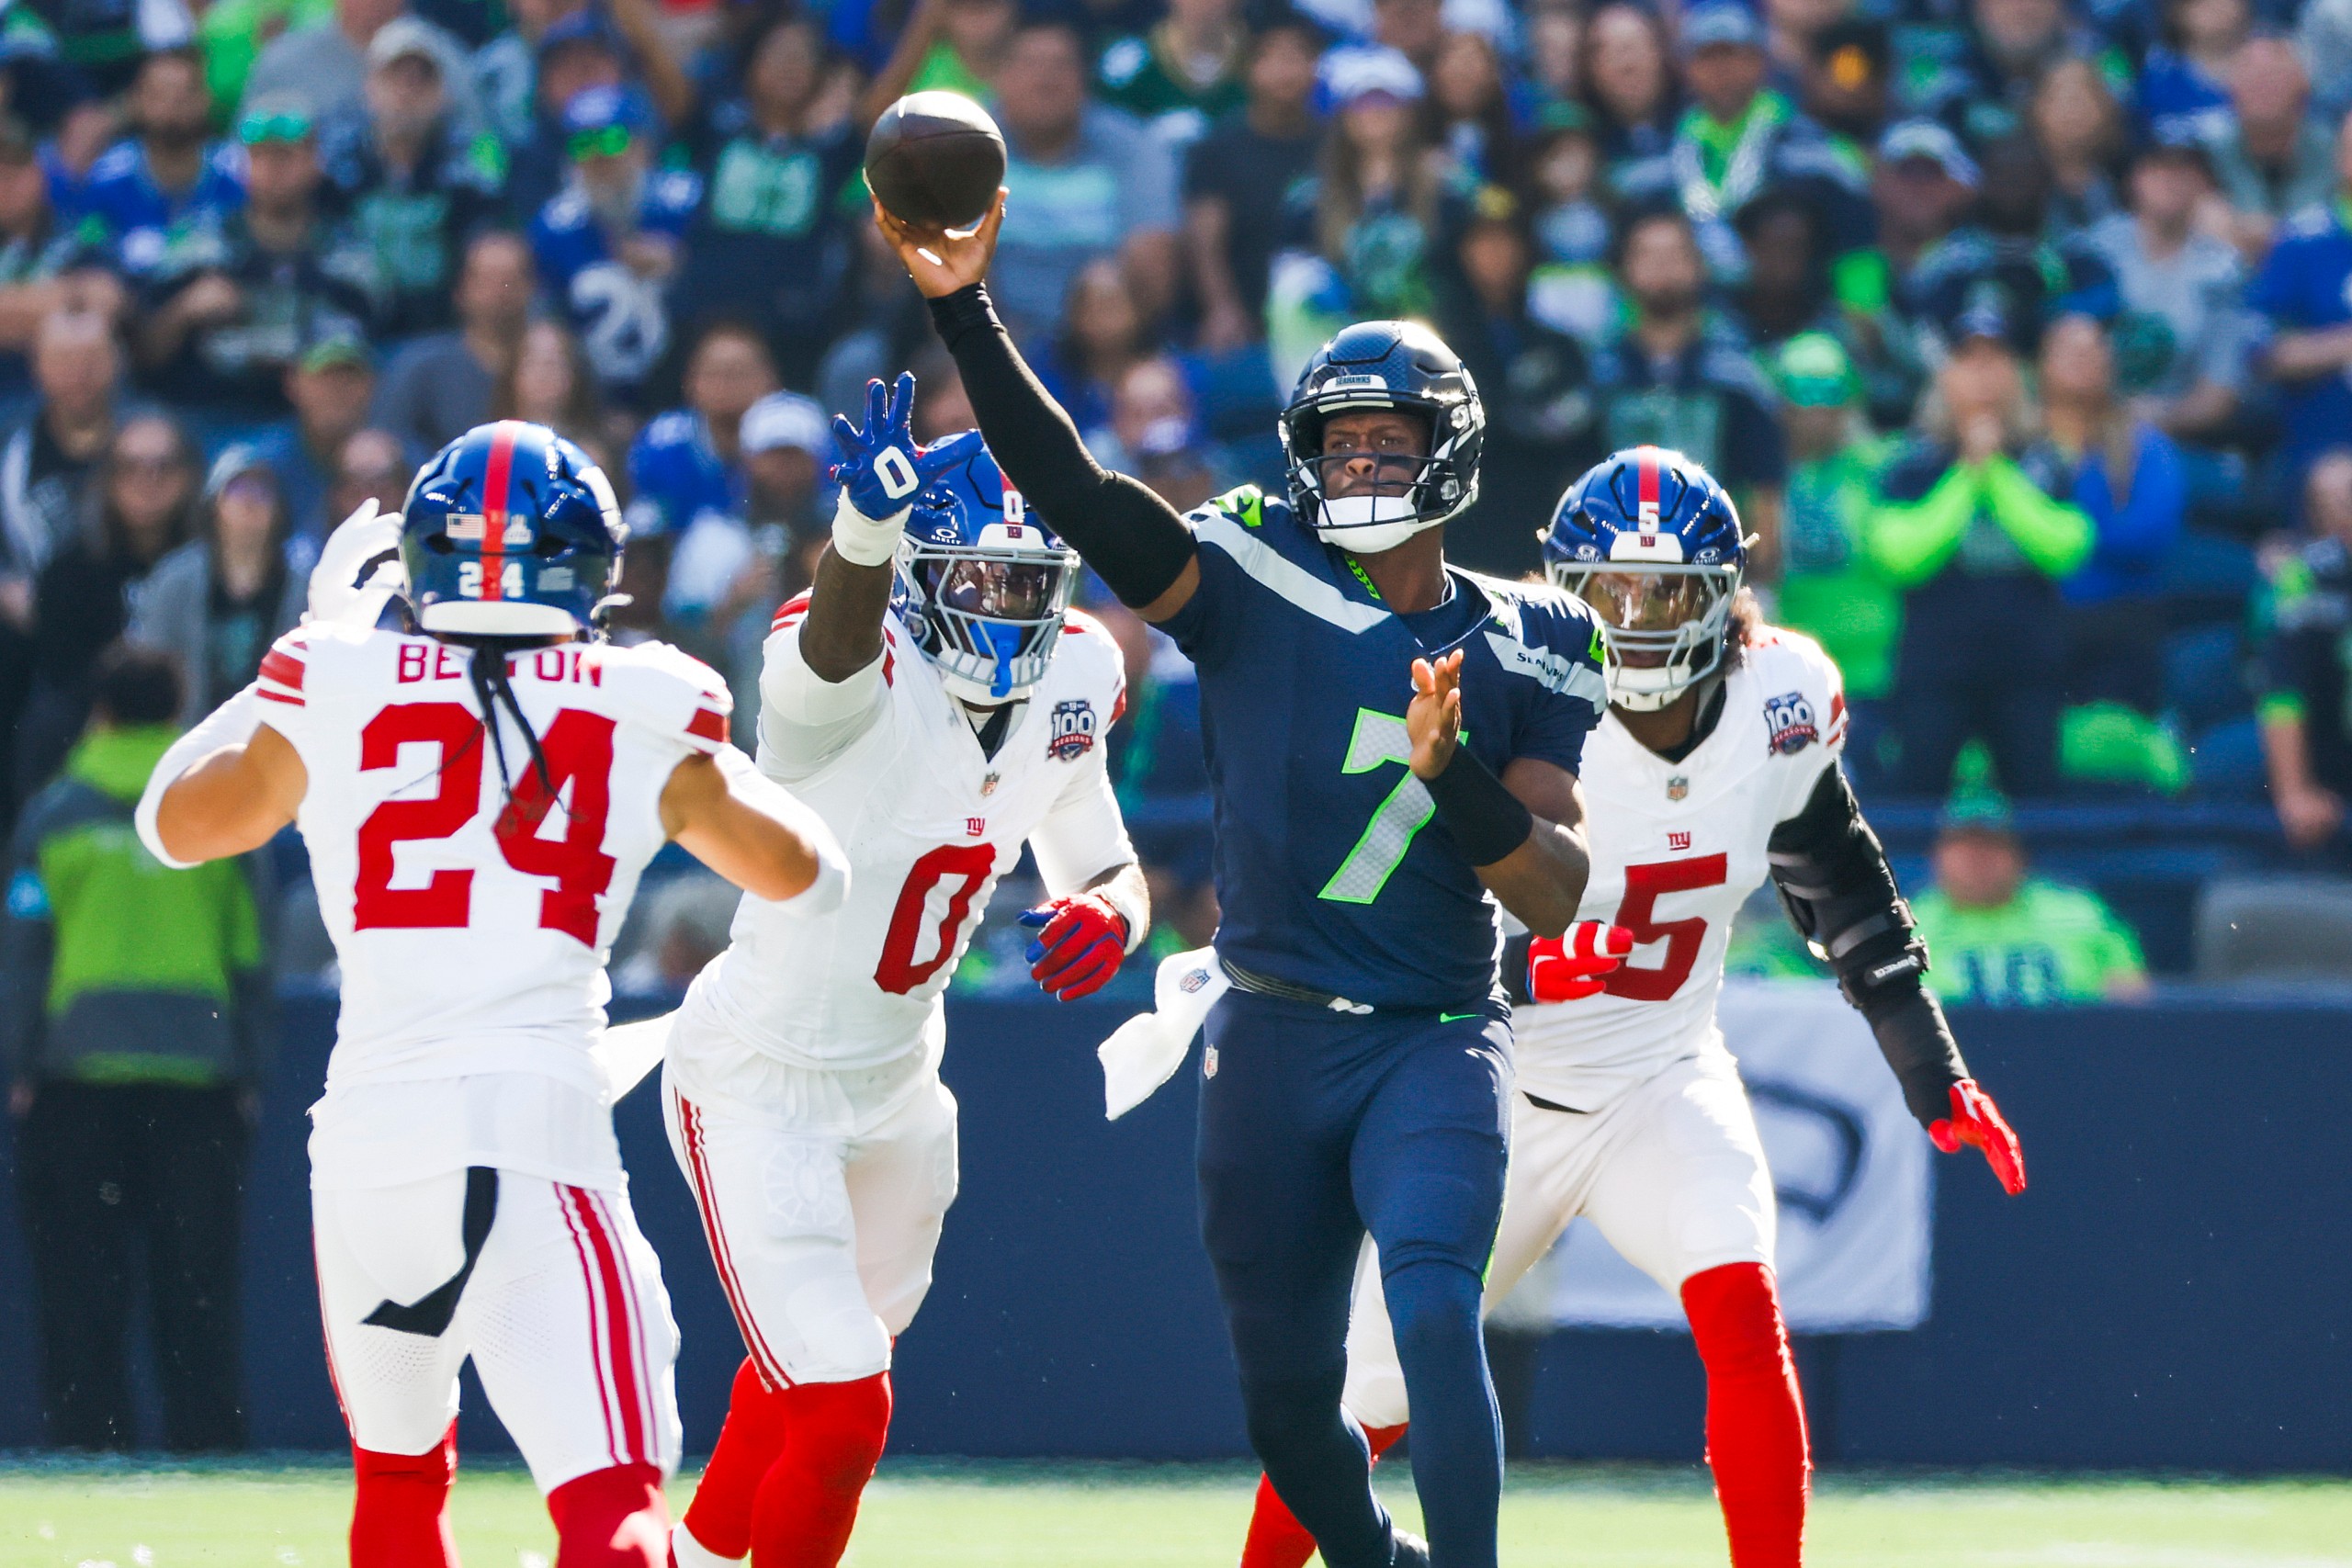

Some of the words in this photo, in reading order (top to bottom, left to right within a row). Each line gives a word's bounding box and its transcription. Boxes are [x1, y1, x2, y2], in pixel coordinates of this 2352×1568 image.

[1335, 375, 1372, 386] SEAHAWKS
[874, 446, 920, 500] 0
[1003, 490, 1025, 524] 0
[1638, 502, 1660, 534] 5
[931, 534, 962, 545] OAKLEY
[458, 561, 525, 598] 24
[399, 644, 602, 688] BEON
[1052, 710, 1095, 740] 100
[1763, 701, 1815, 736] 100
[1055, 735, 1091, 747] SEASONS
[1317, 706, 1469, 904] 7
[353, 702, 617, 950] 24
[873, 842, 996, 995] 0
[1590, 852, 1727, 1001] 5
